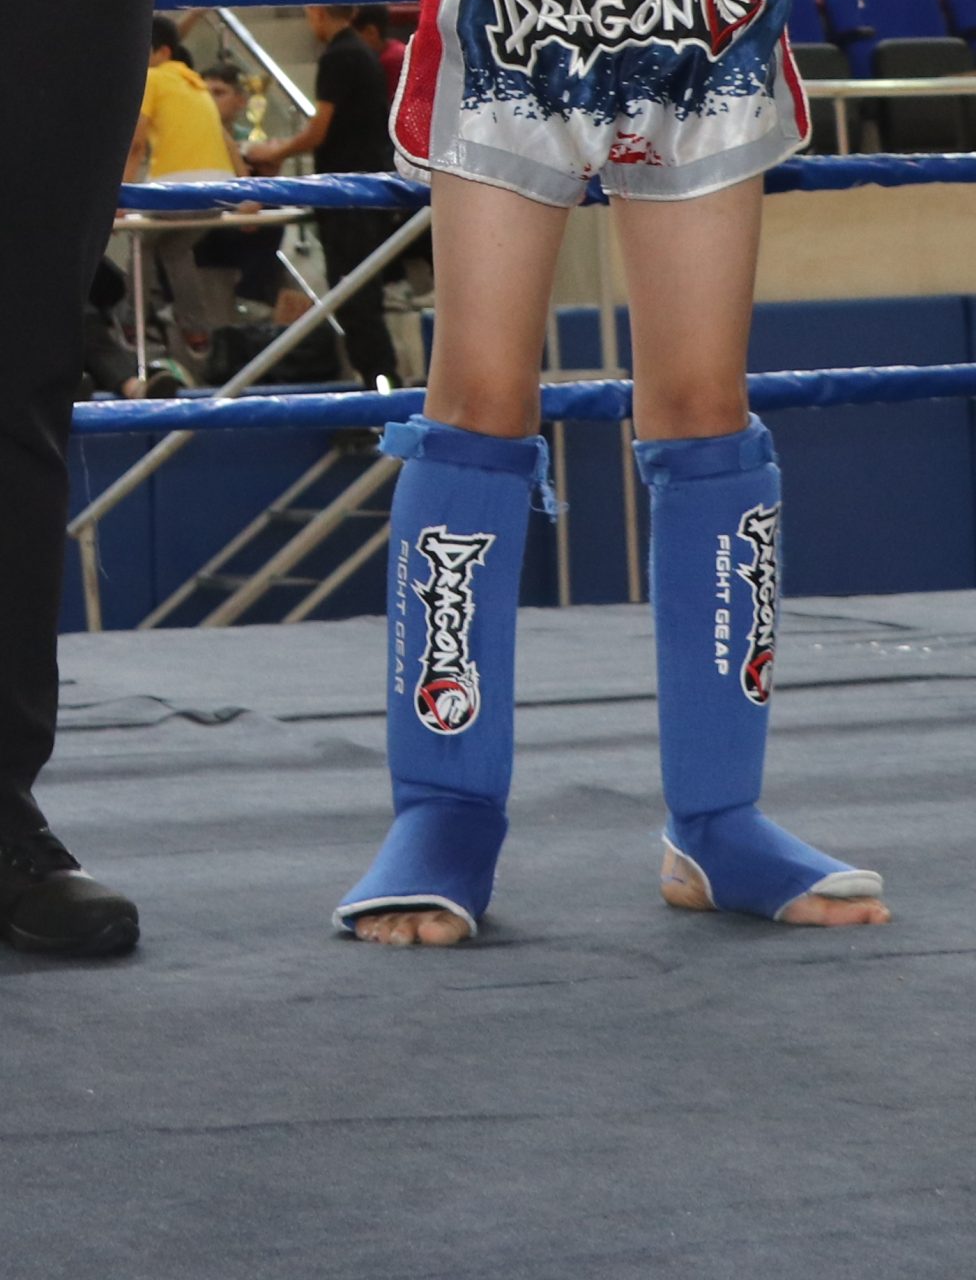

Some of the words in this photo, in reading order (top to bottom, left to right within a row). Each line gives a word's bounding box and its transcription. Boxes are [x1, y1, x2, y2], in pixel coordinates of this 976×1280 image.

[395, 538, 409, 616] FIGHT
[426, 536, 482, 673] DRAGON
[715, 534, 732, 604] FIGHT
[394, 623, 407, 695] GEAR
